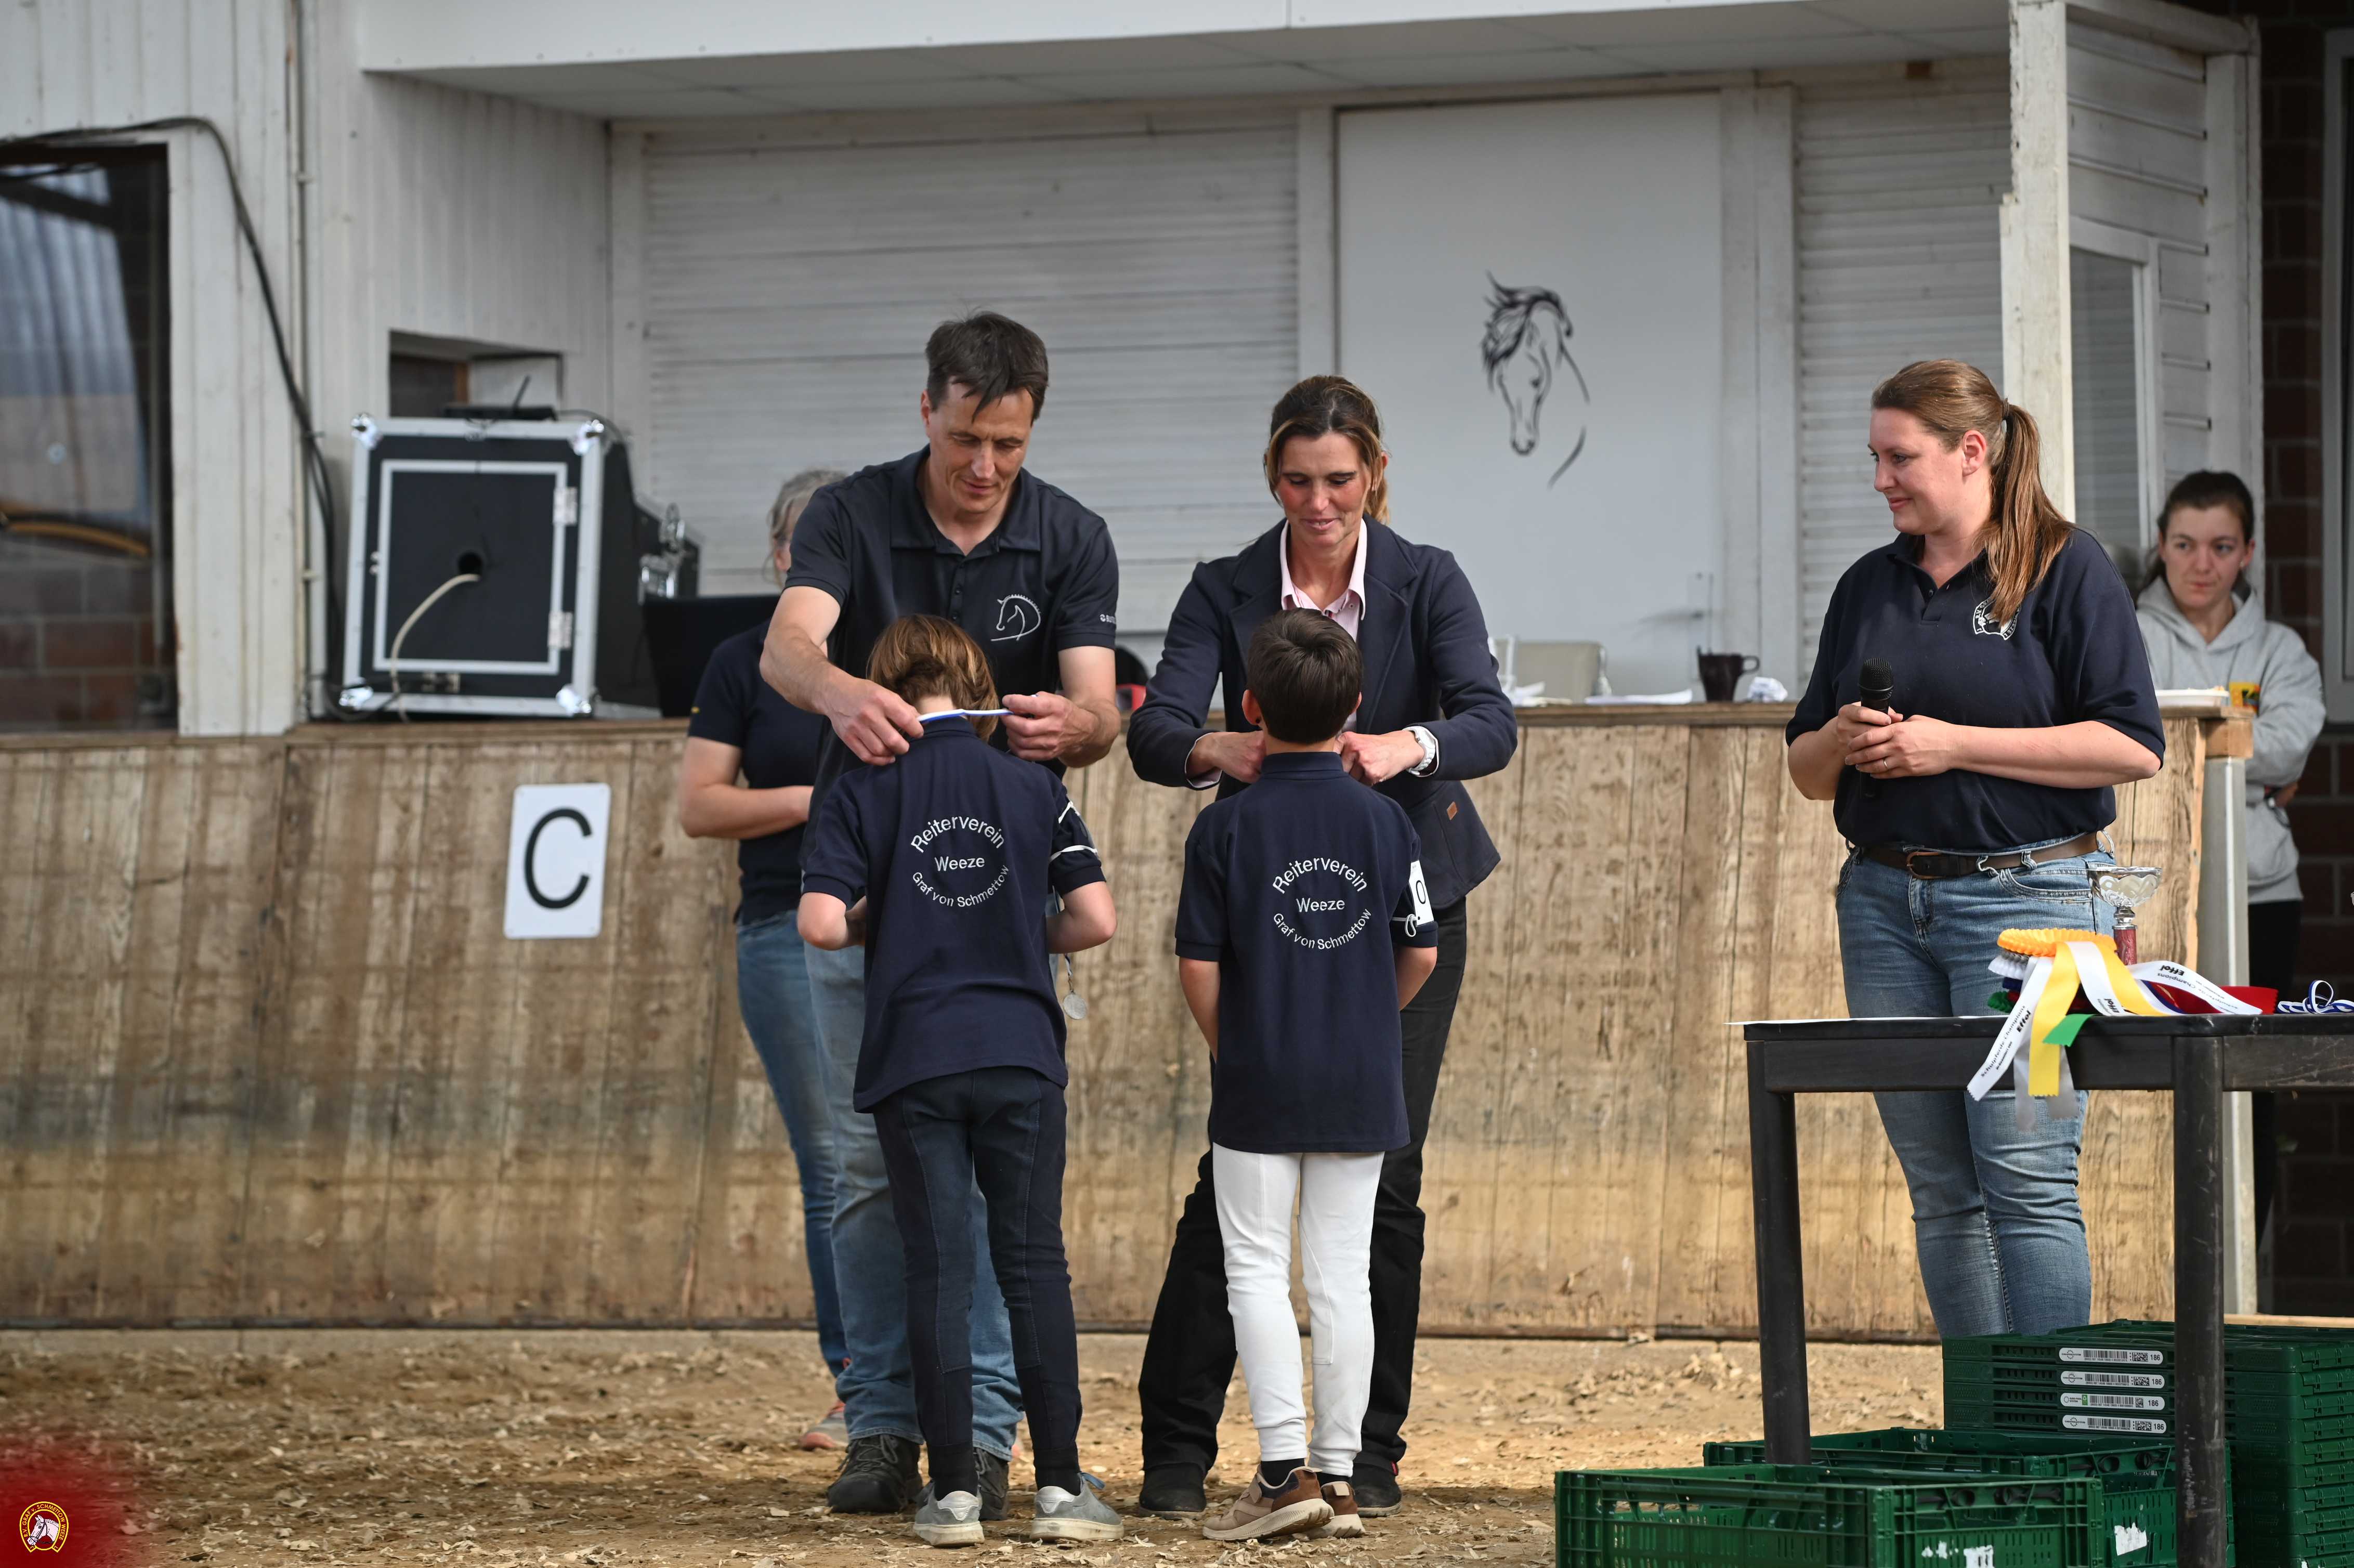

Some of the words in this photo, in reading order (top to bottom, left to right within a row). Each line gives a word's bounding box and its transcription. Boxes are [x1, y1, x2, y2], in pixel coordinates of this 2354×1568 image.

[910, 815, 1005, 853] Reiterverein
[524, 807, 592, 910] C
[934, 856, 985, 872] Weeze
[1272, 857, 1368, 894] Reiterverein
[912, 872, 934, 895] Graf
[932, 892, 954, 907] von
[957, 865, 1010, 908] Schmettow
[1296, 897, 1345, 913] Weeze
[1273, 913, 1296, 937] Graf
[1294, 935, 1315, 949] von
[1317, 908, 1372, 950] Schmettow
[2160, 964, 2185, 976] Effol
[2016, 1010, 2031, 1033] Effol
